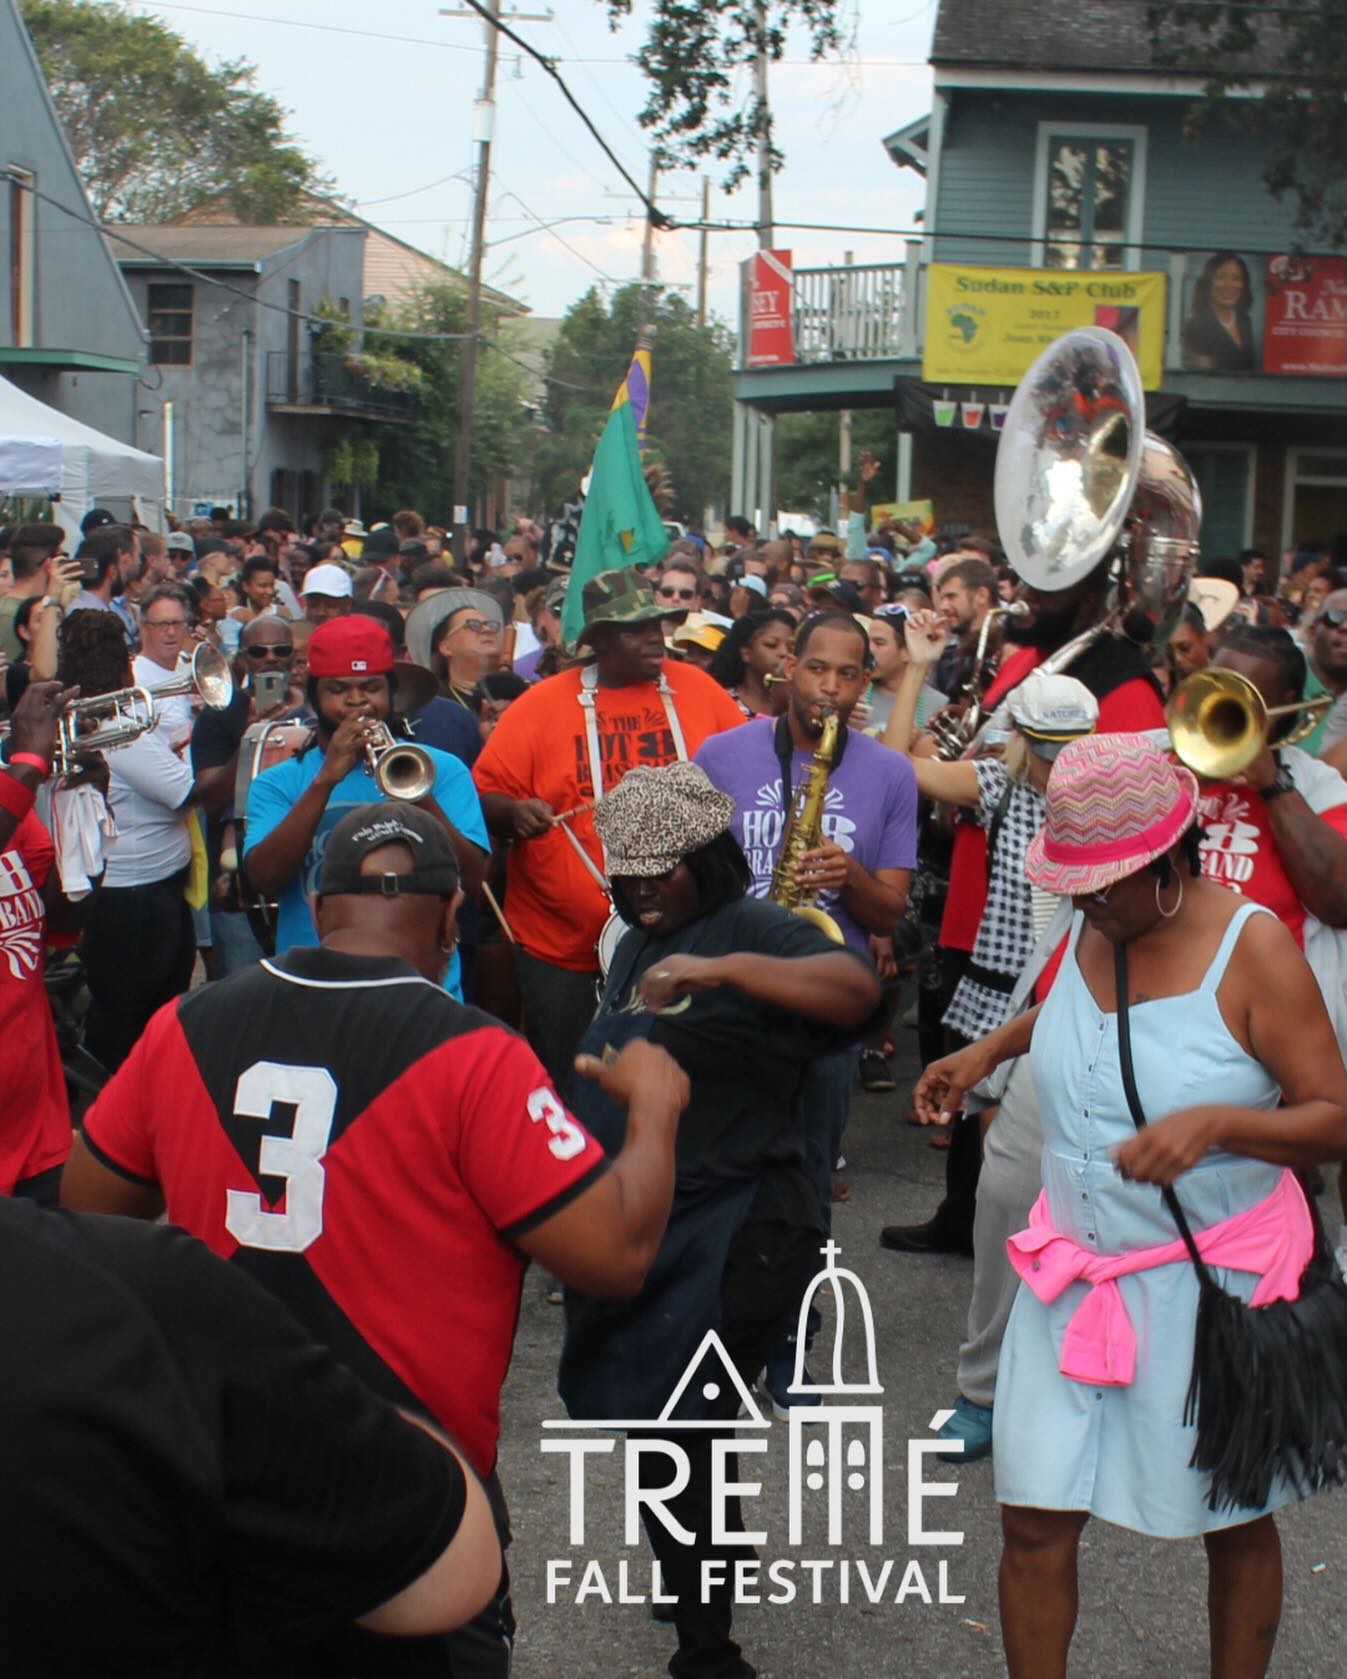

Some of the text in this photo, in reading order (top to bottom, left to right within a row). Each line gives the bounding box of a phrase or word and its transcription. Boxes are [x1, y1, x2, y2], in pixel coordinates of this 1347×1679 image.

[956, 276, 1025, 295] Sudan
[1085, 281, 1137, 299] Club
[225, 1060, 338, 1254] 3
[526, 1086, 587, 1161] 3
